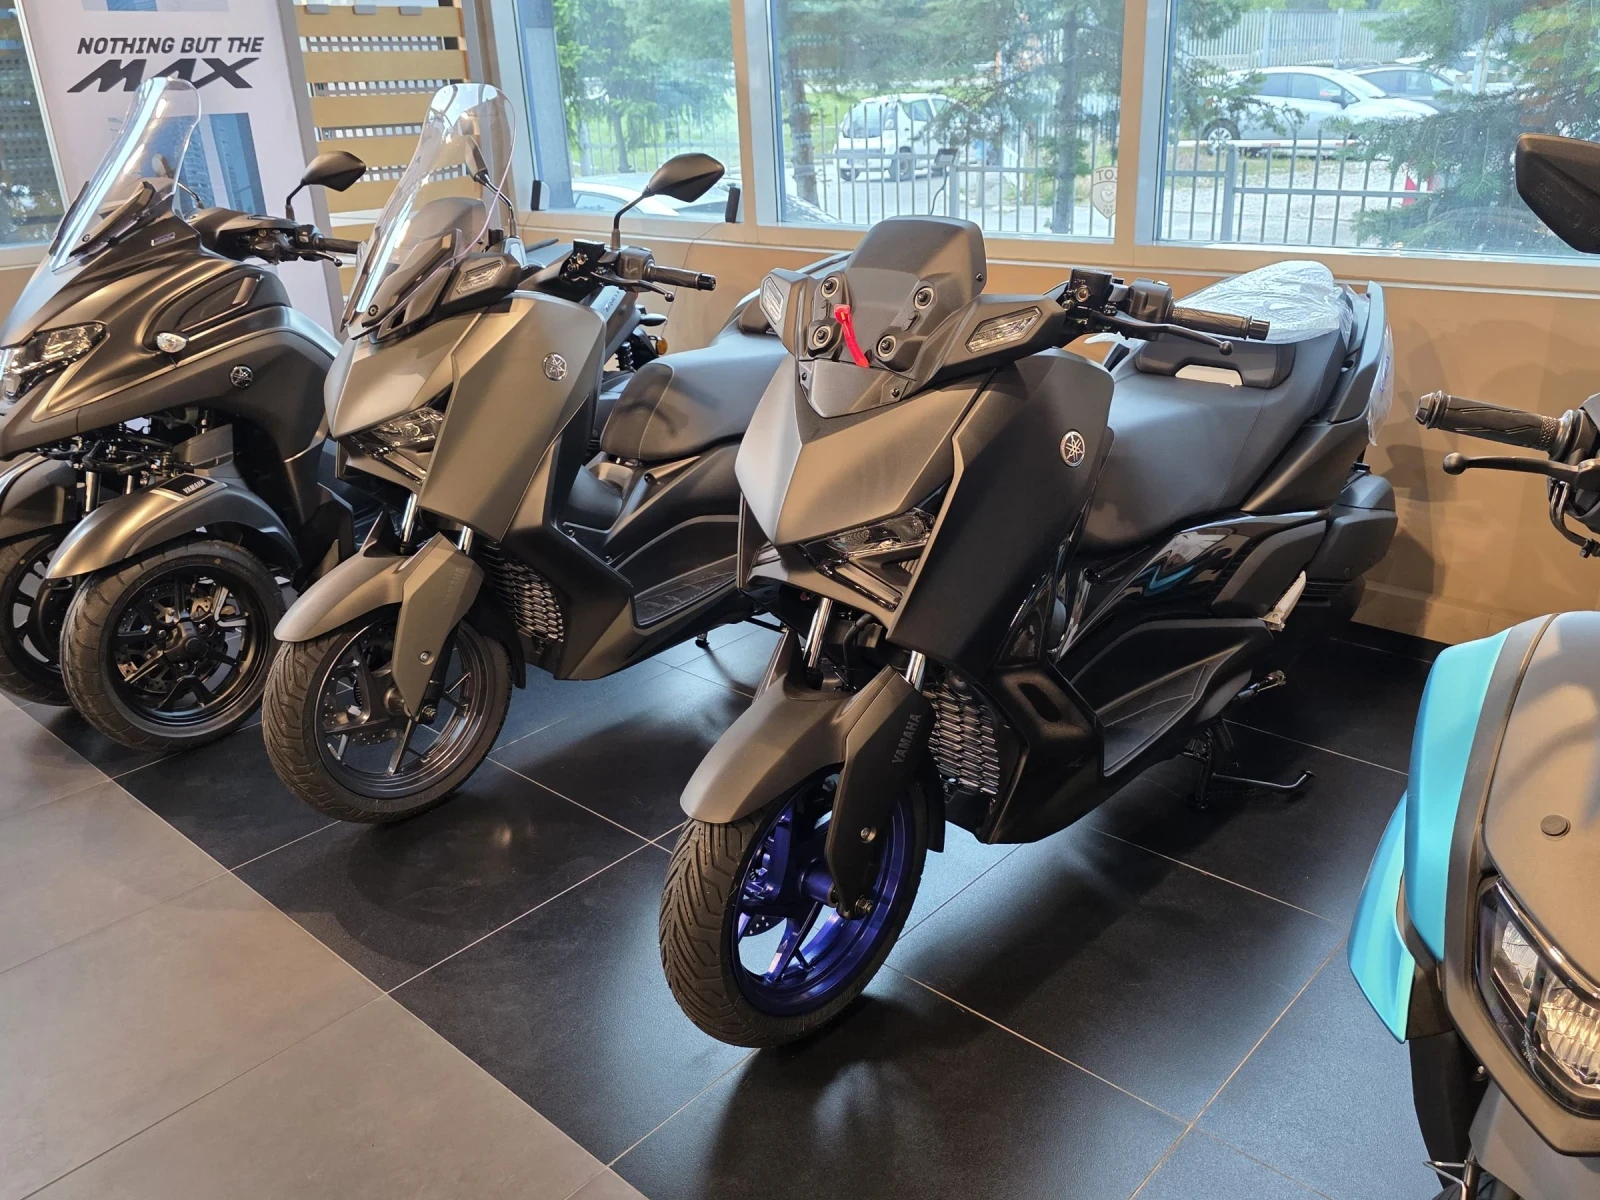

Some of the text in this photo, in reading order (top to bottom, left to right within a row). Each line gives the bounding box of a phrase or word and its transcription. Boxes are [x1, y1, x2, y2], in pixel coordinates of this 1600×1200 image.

[77, 37, 264, 54] NOTHING BUT THE
[66, 57, 260, 93] MAX
[183, 479, 206, 494] YAMAHA
[891, 713, 922, 764] YAMAHA
